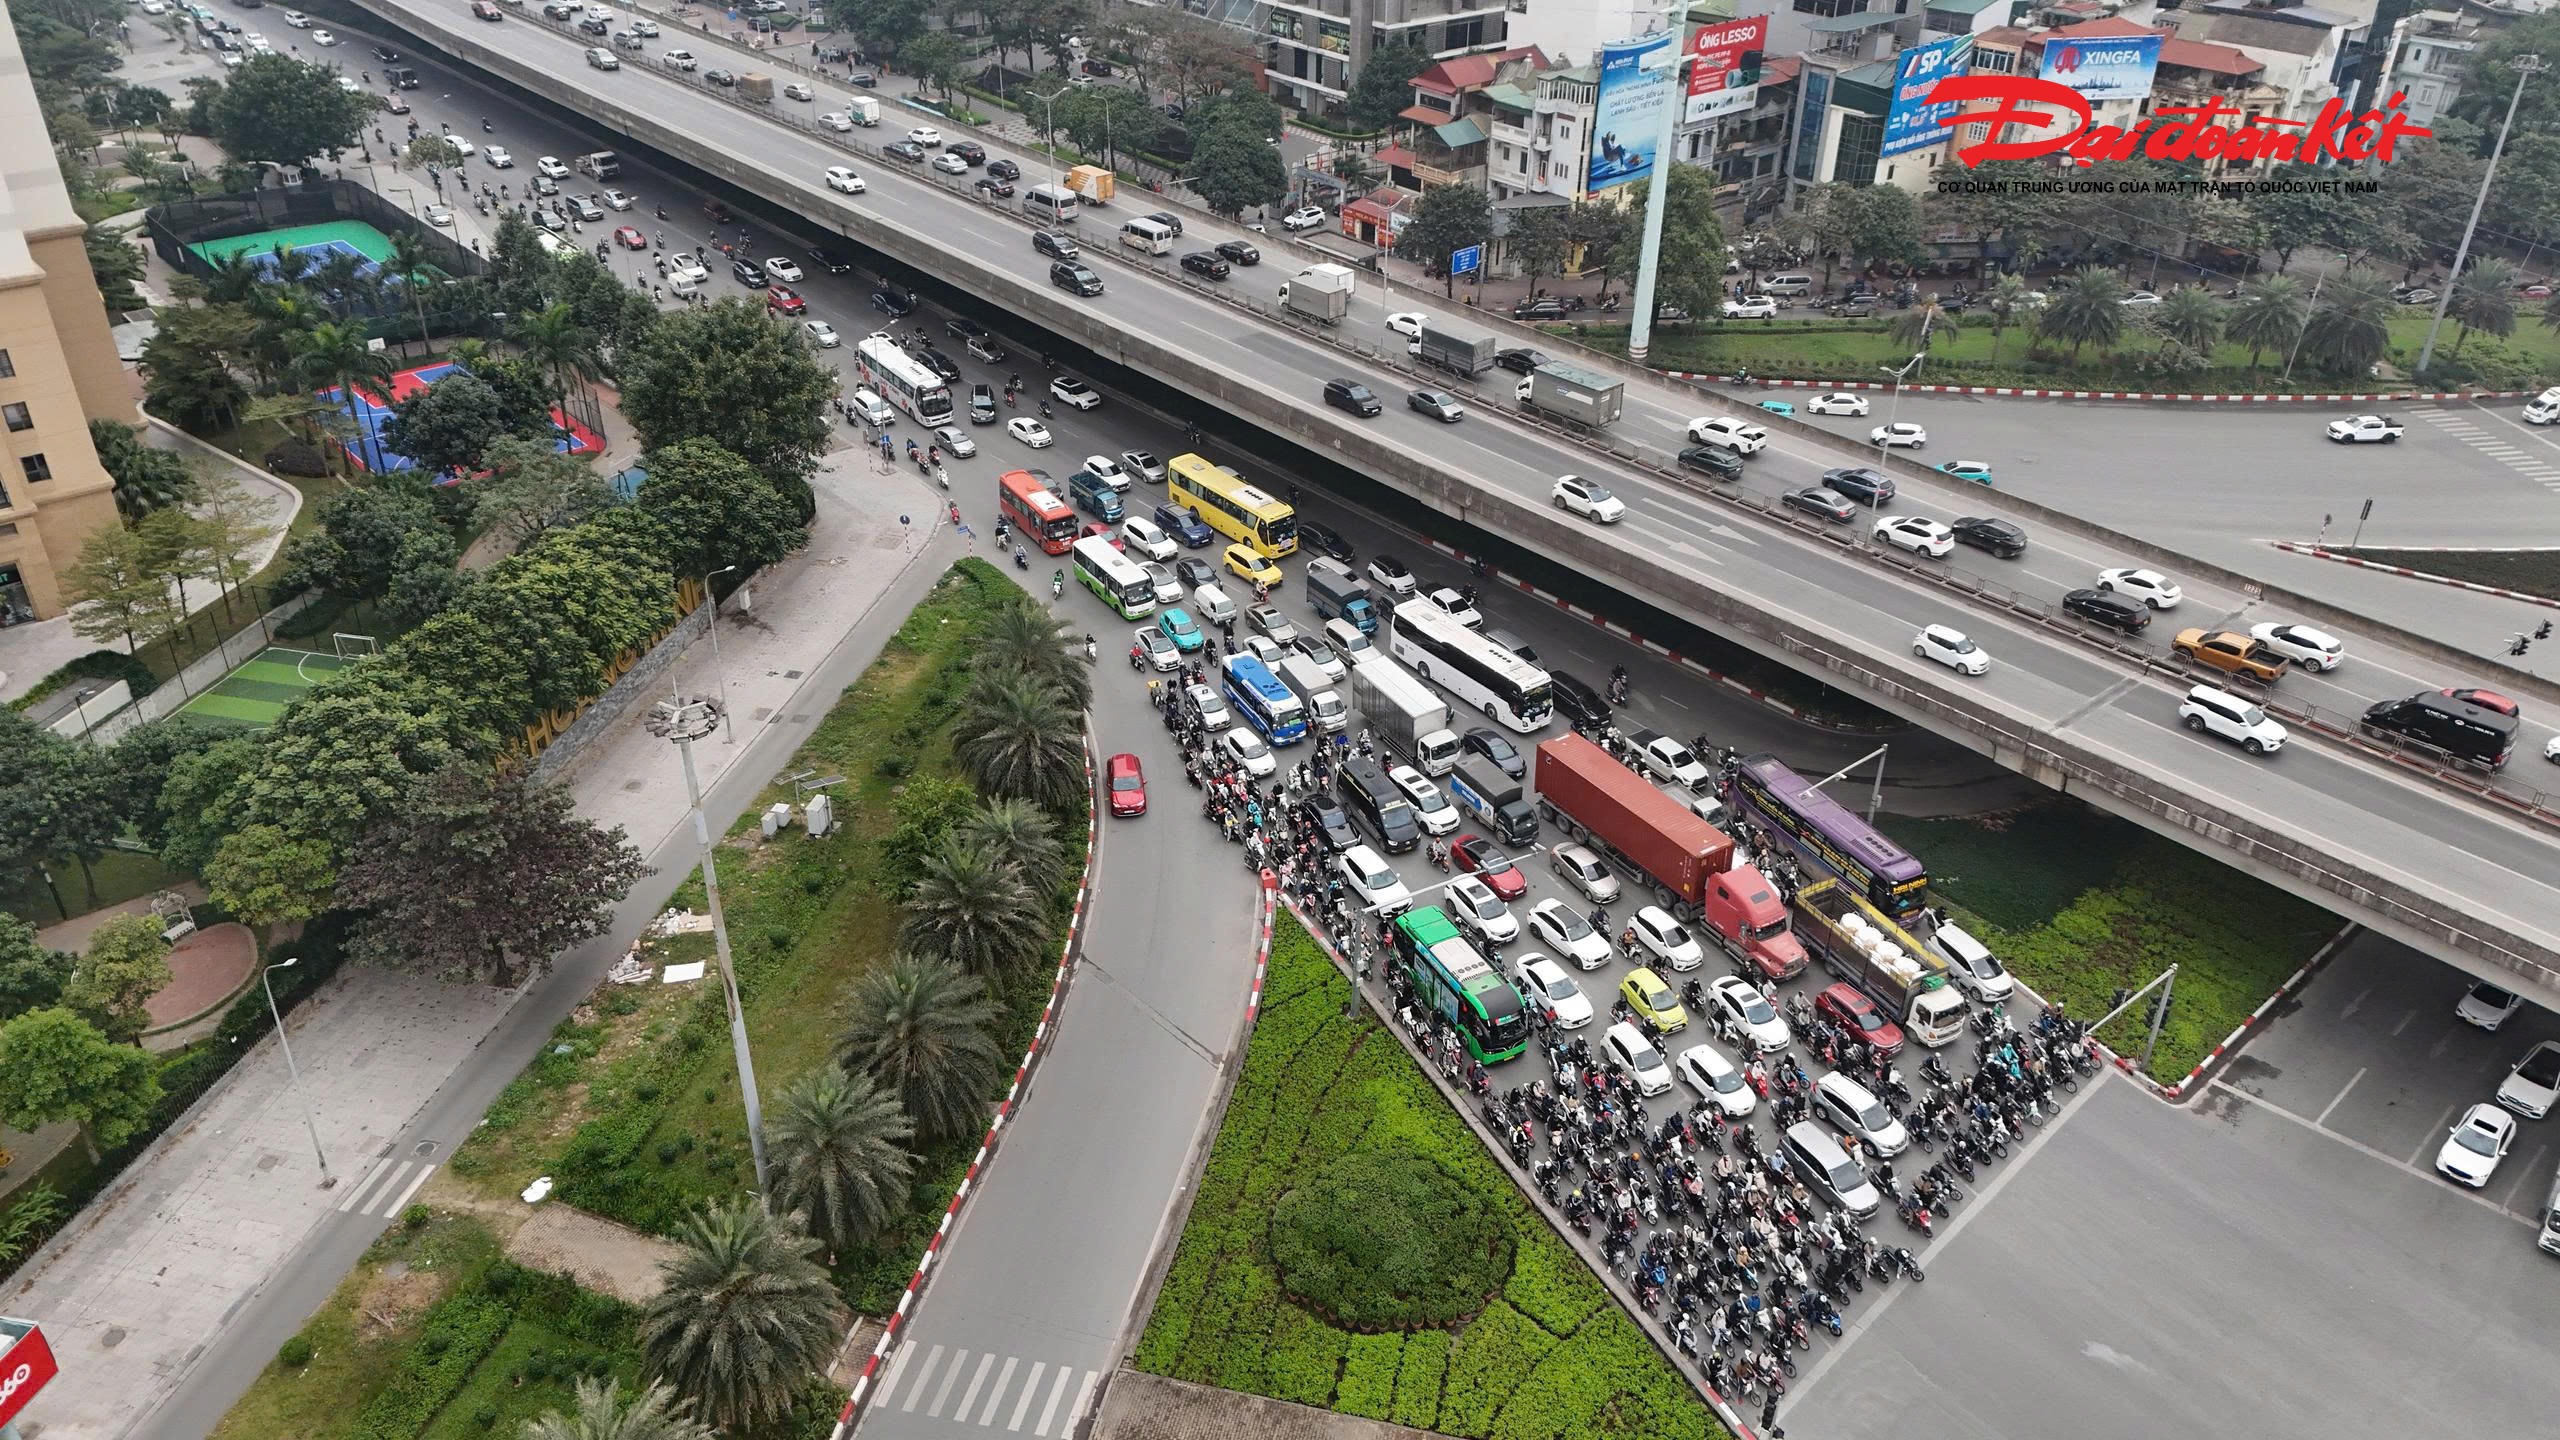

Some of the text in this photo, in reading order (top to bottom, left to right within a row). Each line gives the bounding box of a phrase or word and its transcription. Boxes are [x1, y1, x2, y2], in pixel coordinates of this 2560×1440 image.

[1700, 26, 1756, 49] ỐNG LESSO
[2083, 50, 2141, 65] XINGFA
